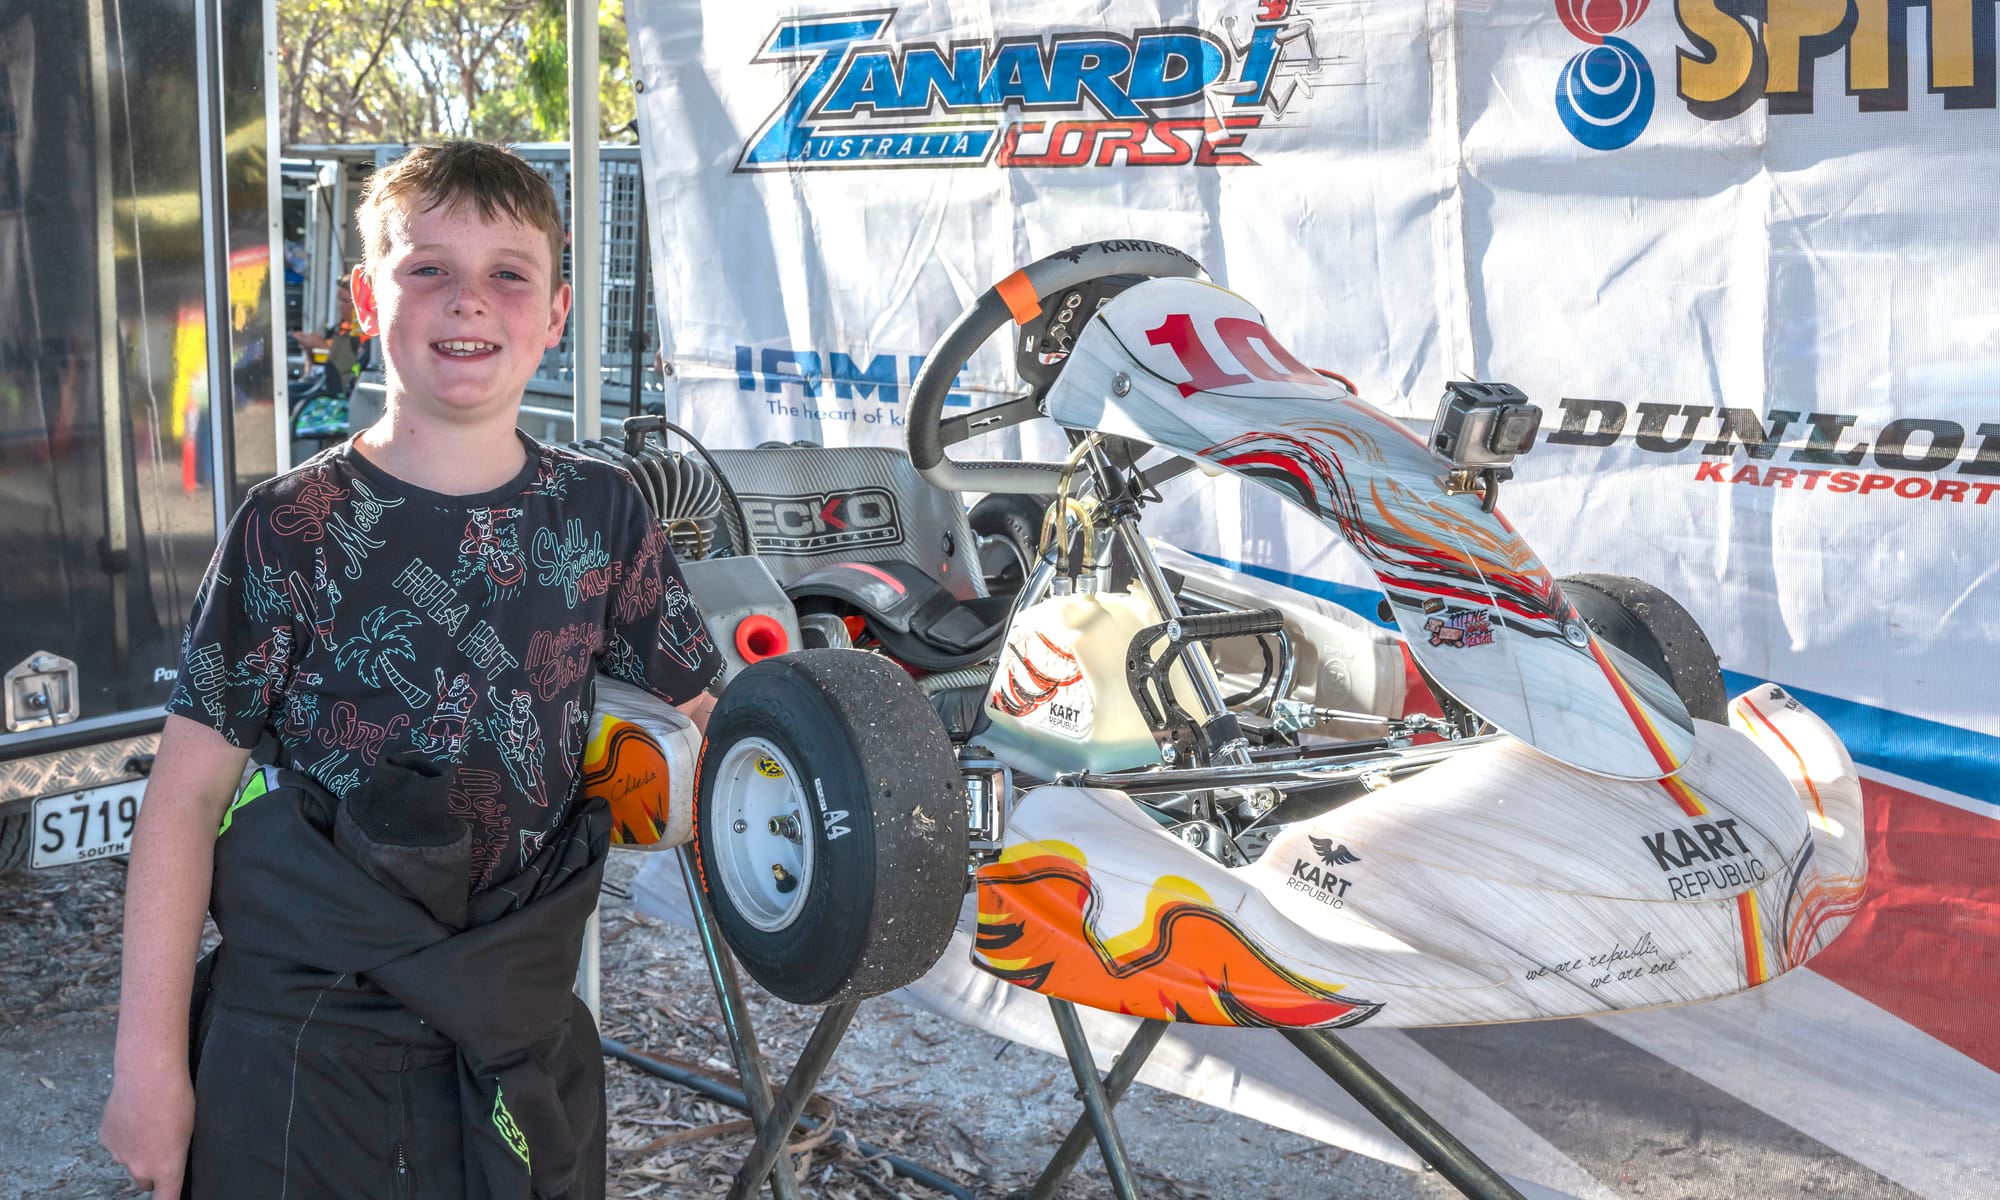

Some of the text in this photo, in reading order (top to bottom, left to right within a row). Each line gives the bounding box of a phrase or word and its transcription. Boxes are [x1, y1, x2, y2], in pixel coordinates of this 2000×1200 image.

[800, 135, 970, 159] AUSTRALIA
[996, 115, 1262, 168] CORSE
[1145, 313, 1329, 399] 10
[766, 400, 799, 417] The
[804, 402, 857, 422] heart
[864, 407, 883, 425] of
[1694, 460, 2000, 504] KARTSPORT
[326, 478, 405, 580] Motel
[742, 493, 892, 536] ECKO
[754, 529, 891, 548] CING SEATS
[392, 557, 519, 681] HULA HUT
[1049, 716, 1080, 733] REPUBLIC
[1050, 702, 1080, 724] KART
[77, 842, 125, 860] SOUTH
[1641, 818, 1751, 872] KART
[1286, 876, 1344, 910] REPUBLIC
[1292, 858, 1353, 899] KART
[1667, 858, 1766, 901] REPUBLIC
[1525, 965, 1551, 981] we
[1554, 959, 1584, 973] are
[1590, 960, 1678, 989] we are one
